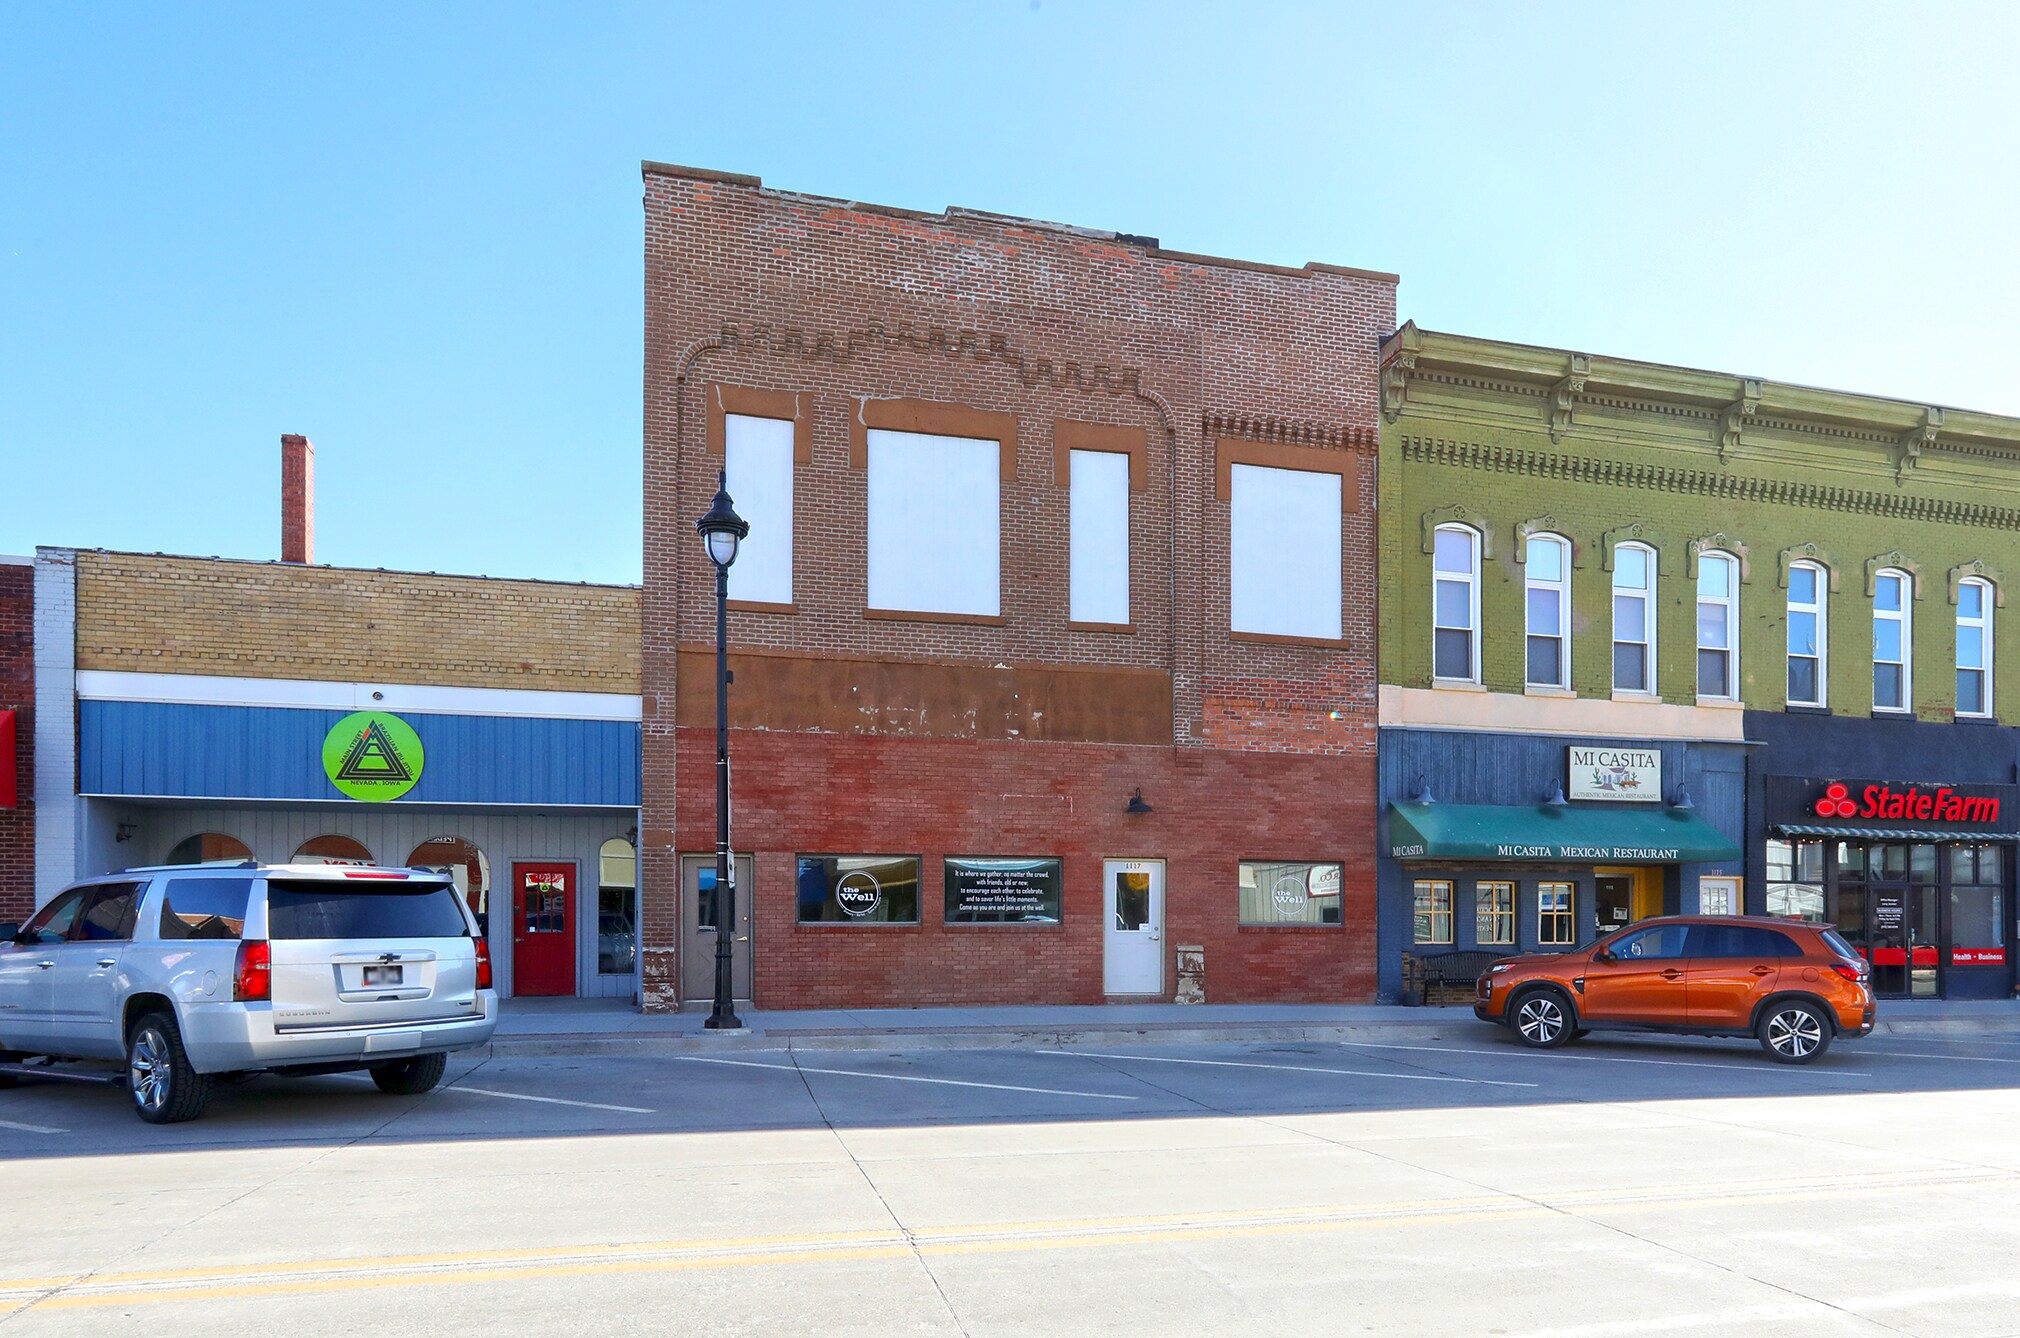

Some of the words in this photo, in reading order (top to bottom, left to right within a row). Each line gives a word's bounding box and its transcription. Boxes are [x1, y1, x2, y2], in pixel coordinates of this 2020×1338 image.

[339, 747, 352, 765] MAIN
[350, 730, 364, 749] STREET
[378, 722, 399, 751] BRAZILIAN
[396, 751, 415, 777] JIU-JITSU
[1573, 751, 1595, 766] MI
[1598, 751, 1656, 768] CASITA
[1392, 846, 1401, 857] MI
[1401, 845, 1424, 857] CASITA
[1498, 845, 1513, 856] MI
[1513, 845, 1552, 857] CASITA
[1560, 846, 1609, 858] MEXICAN
[1613, 847, 1679, 859] RESTAURANT
[987, 870, 1003, 878] gather,
[839, 893, 875, 901] Well
[1274, 896, 1304, 904] Well
[959, 903, 972, 911] Come
[1006, 904, 1014, 912] join
